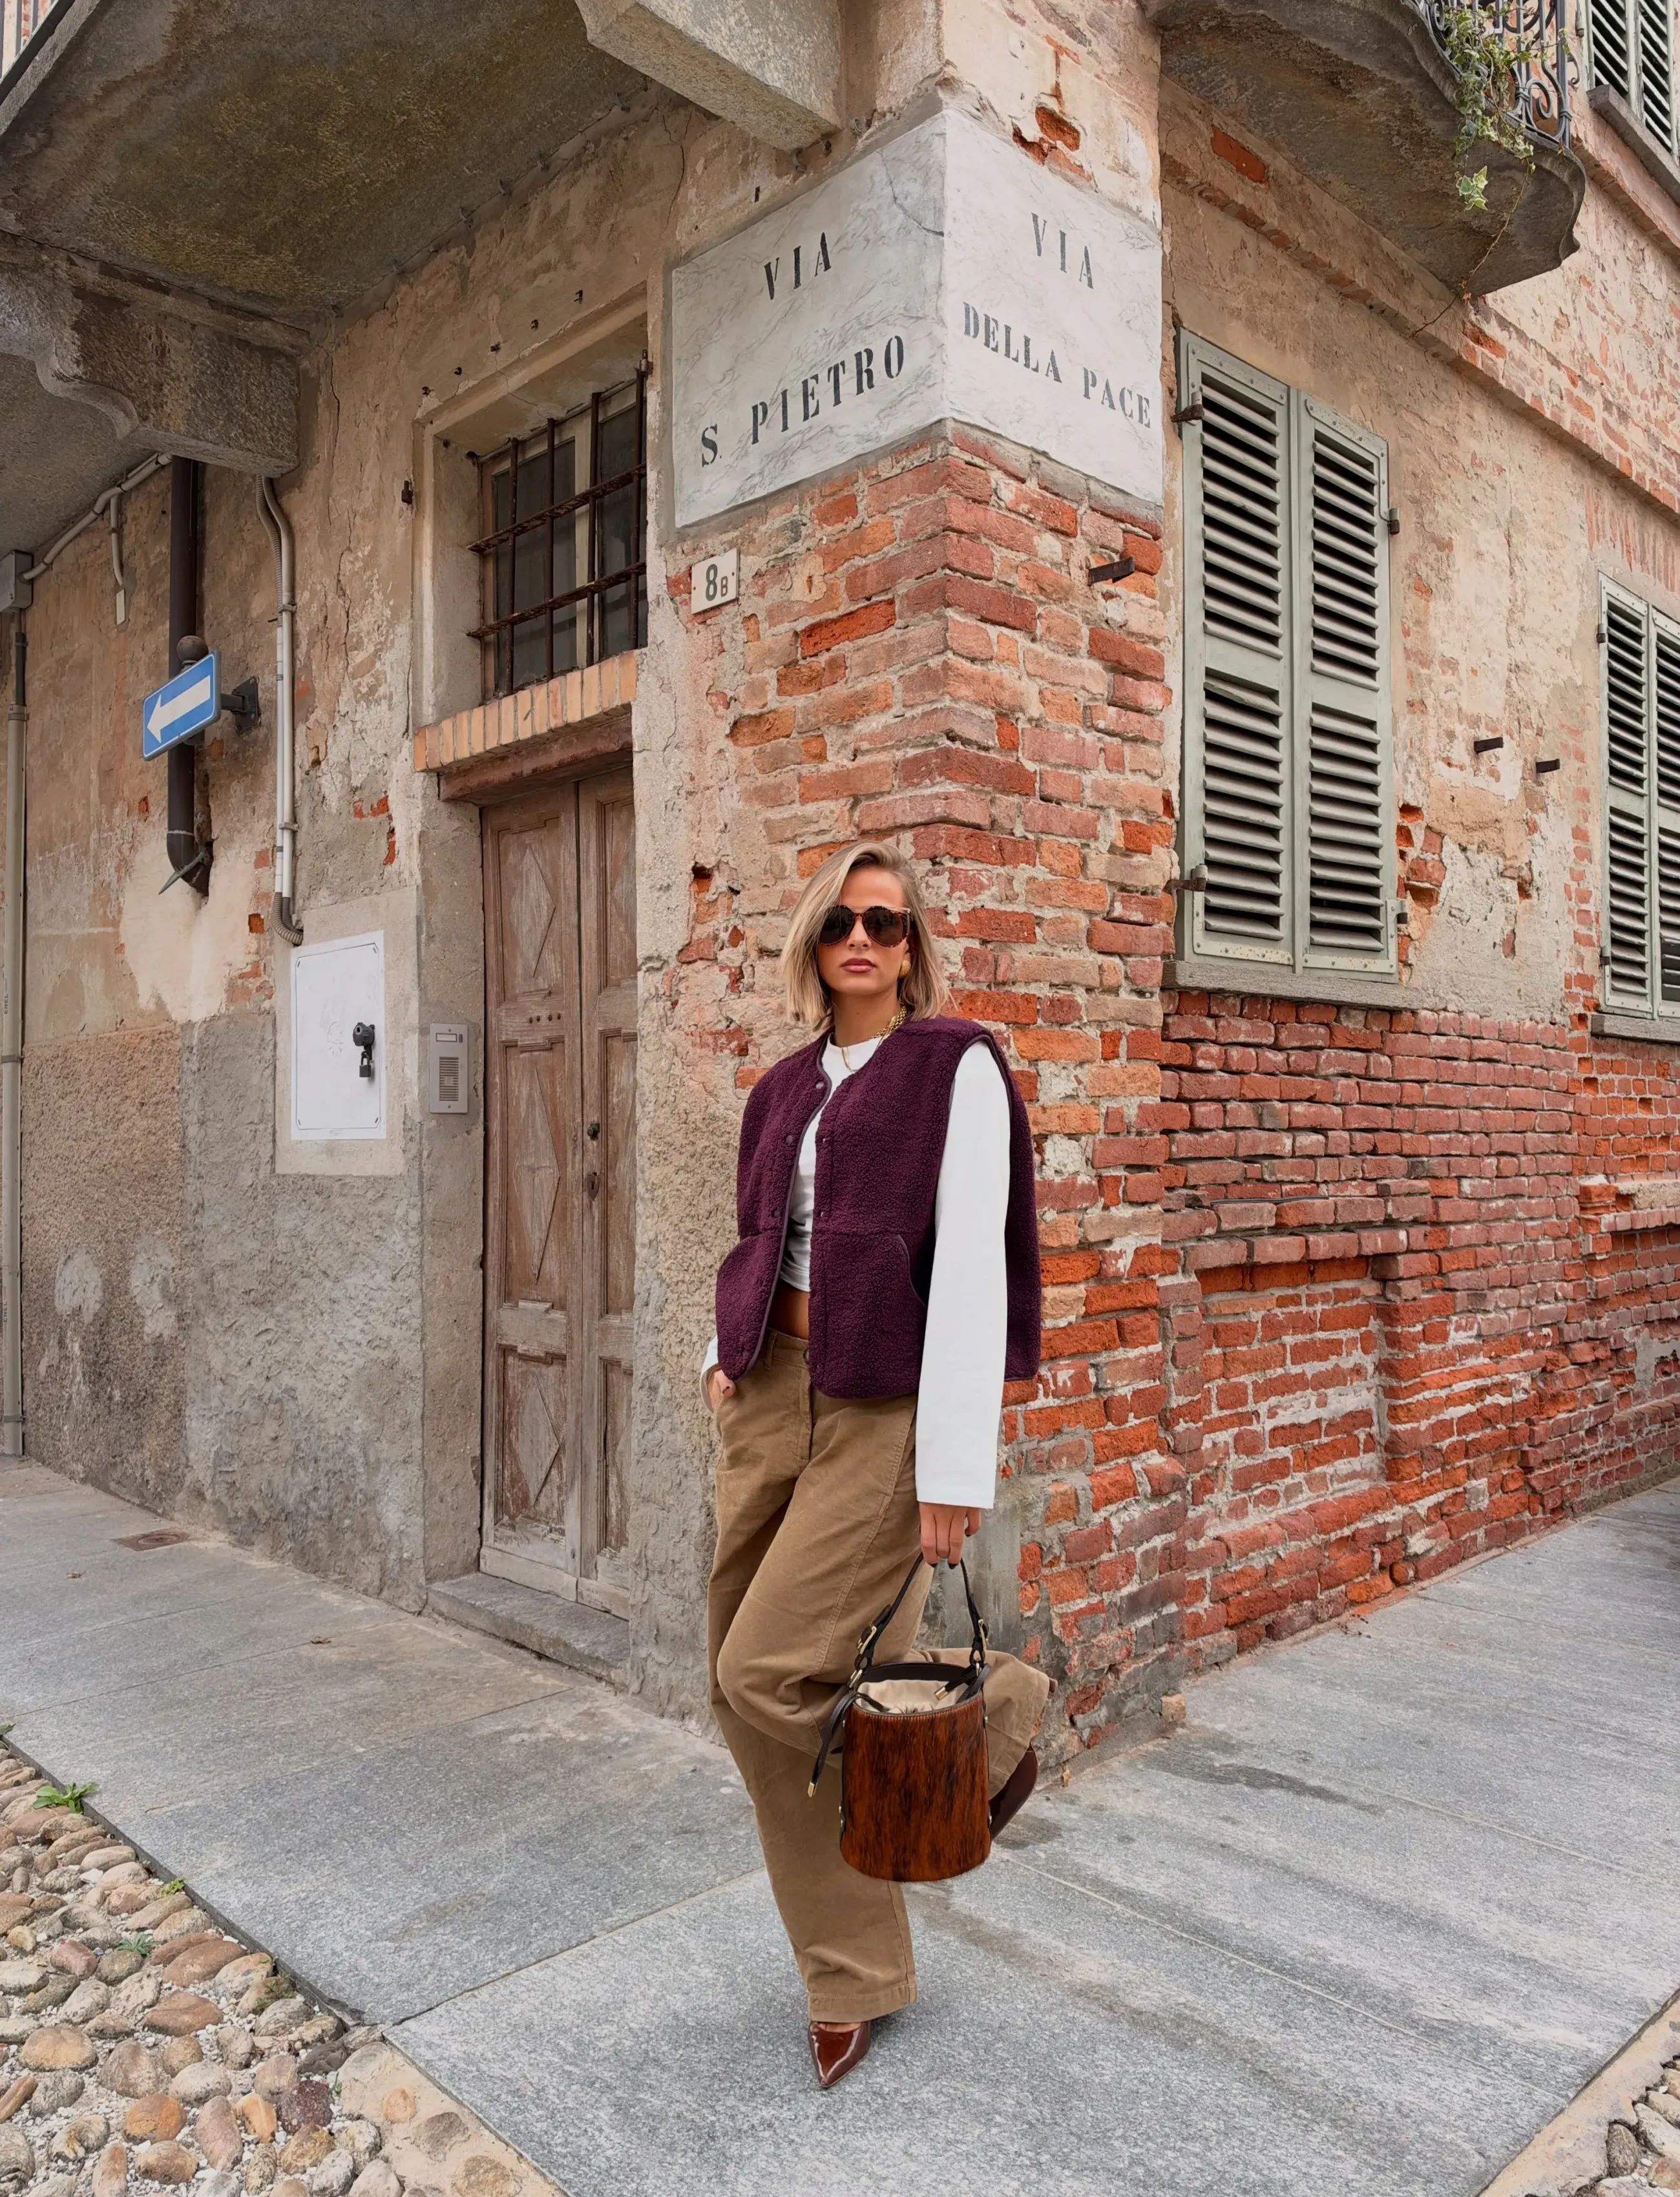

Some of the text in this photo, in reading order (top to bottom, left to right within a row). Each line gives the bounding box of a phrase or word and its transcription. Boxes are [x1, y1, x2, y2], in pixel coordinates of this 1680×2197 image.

[764, 231, 832, 300] VIA
[1031, 212, 1094, 289] VIA
[701, 335, 905, 468] S. PIETRO
[963, 301, 1151, 429] DELLA PACE
